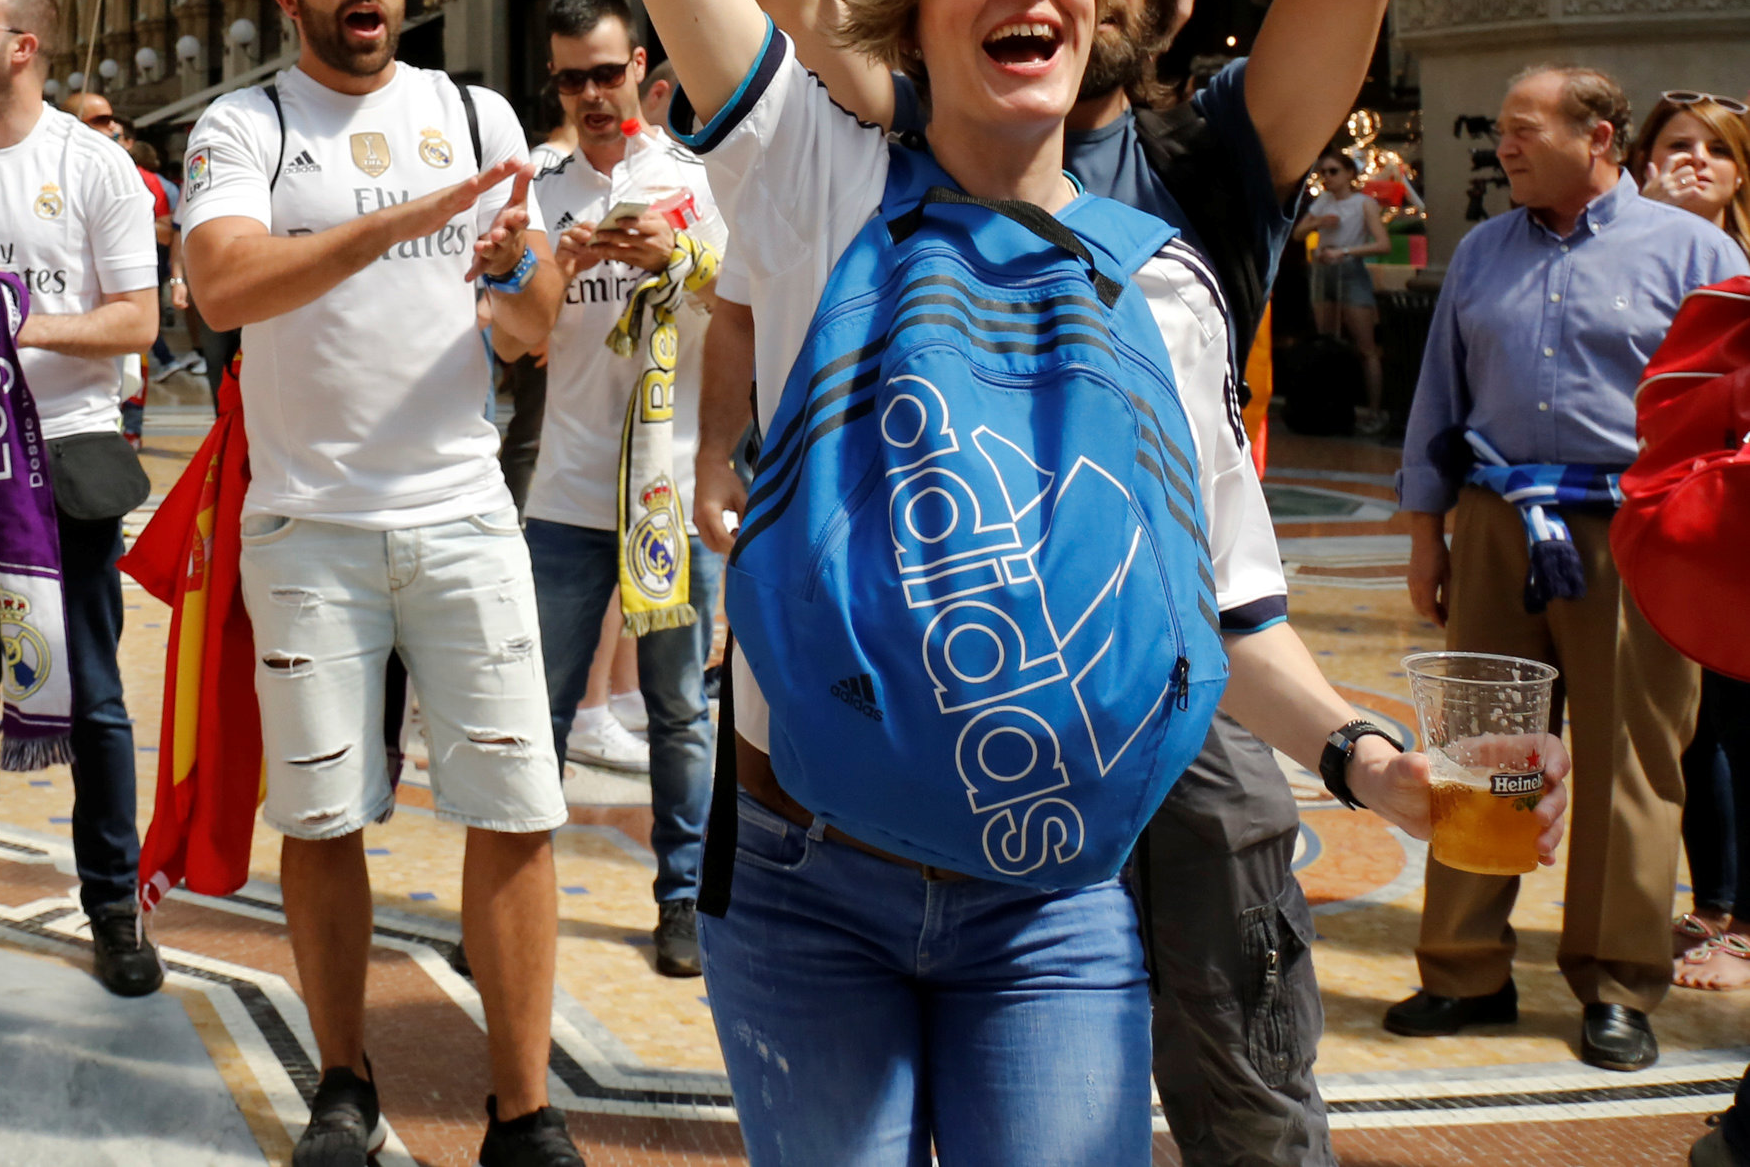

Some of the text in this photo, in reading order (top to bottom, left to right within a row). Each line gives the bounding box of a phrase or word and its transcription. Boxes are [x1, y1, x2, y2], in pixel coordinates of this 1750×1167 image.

[283, 163, 322, 175] adidas
[24, 417, 44, 489] Desde
[880, 374, 1086, 876] adidas
[830, 684, 884, 723] adidas
